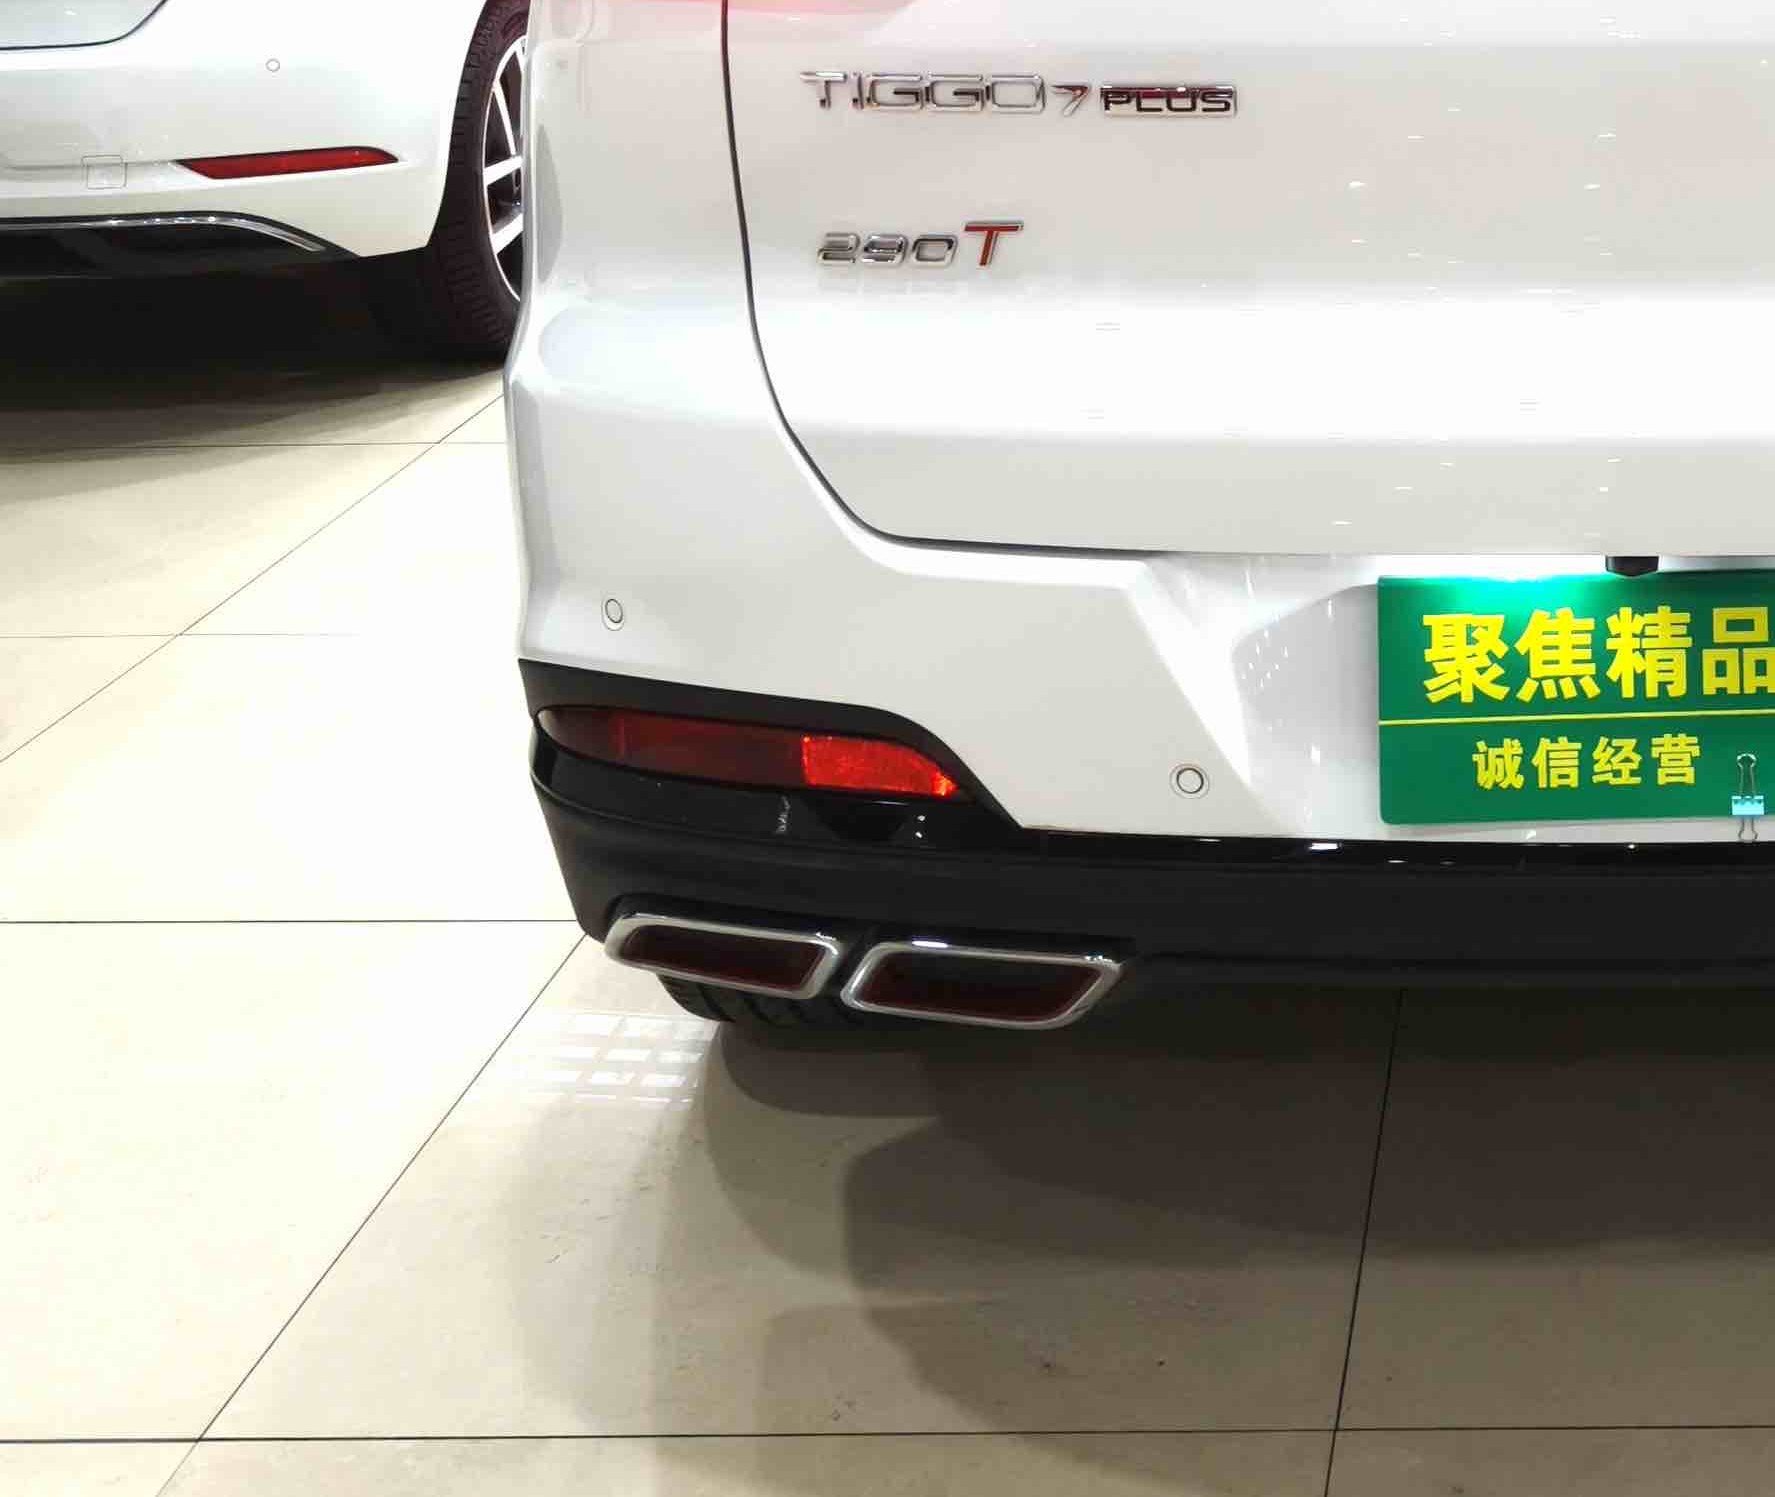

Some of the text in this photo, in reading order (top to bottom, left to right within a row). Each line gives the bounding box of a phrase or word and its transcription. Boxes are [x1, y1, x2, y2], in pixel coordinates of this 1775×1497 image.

[1100, 83, 1238, 118] PLUS
[1472, 733, 1701, 790] 诚信经营
